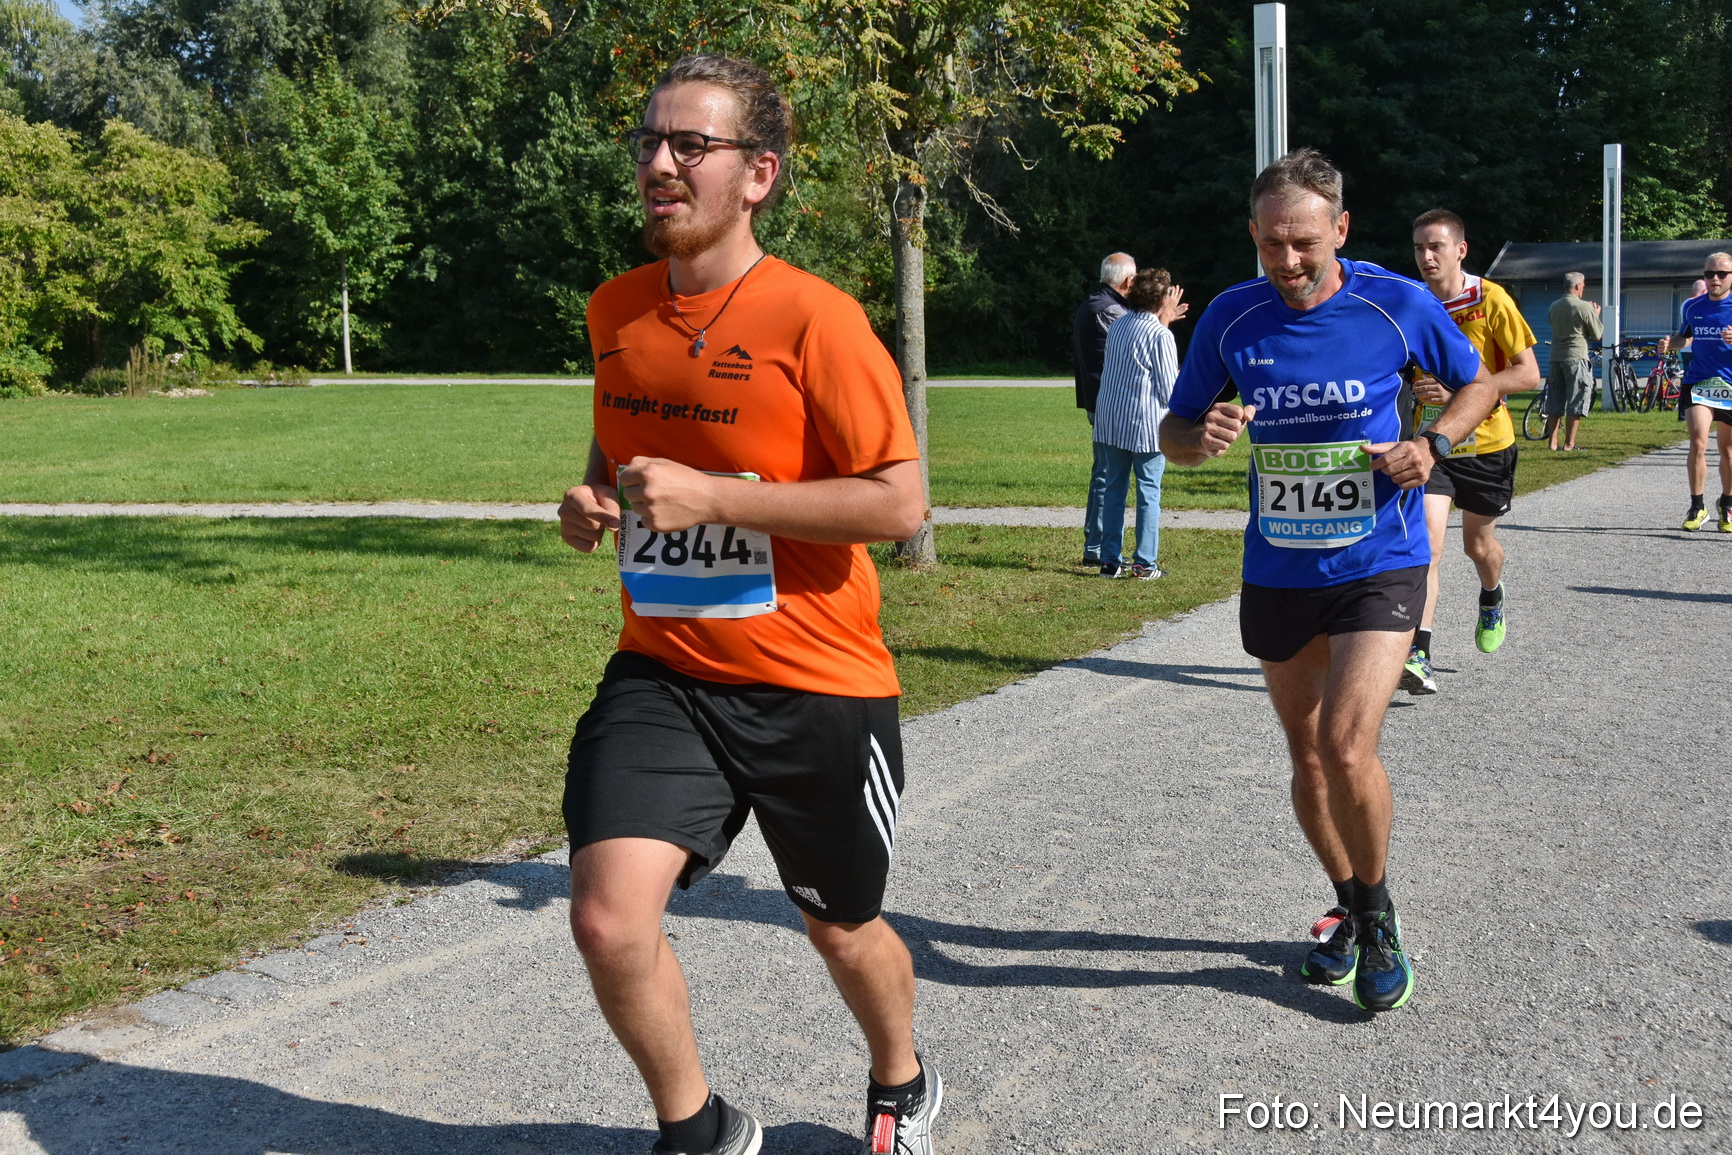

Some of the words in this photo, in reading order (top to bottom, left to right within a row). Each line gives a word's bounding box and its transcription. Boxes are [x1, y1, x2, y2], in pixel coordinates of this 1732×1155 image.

[1452, 309, 1485, 326] ÖGL
[712, 360, 753, 371] Kettenbach
[1257, 358, 1274, 366] JAKO
[708, 370, 751, 382] Runners
[1253, 380, 1366, 410] SYSCAD
[1696, 388, 1730, 399] 2140
[602, 391, 612, 408] It
[613, 394, 659, 417] might
[661, 402, 690, 421] get
[692, 405, 739, 425] fast!
[1253, 408, 1374, 427] www.metallbau-cad.de
[1263, 446, 1360, 471] BOCK
[1270, 480, 1360, 513] 2149
[1268, 521, 1363, 536] WOLFGANG
[633, 521, 752, 568] 2844
[792, 885, 827, 909] adidas
